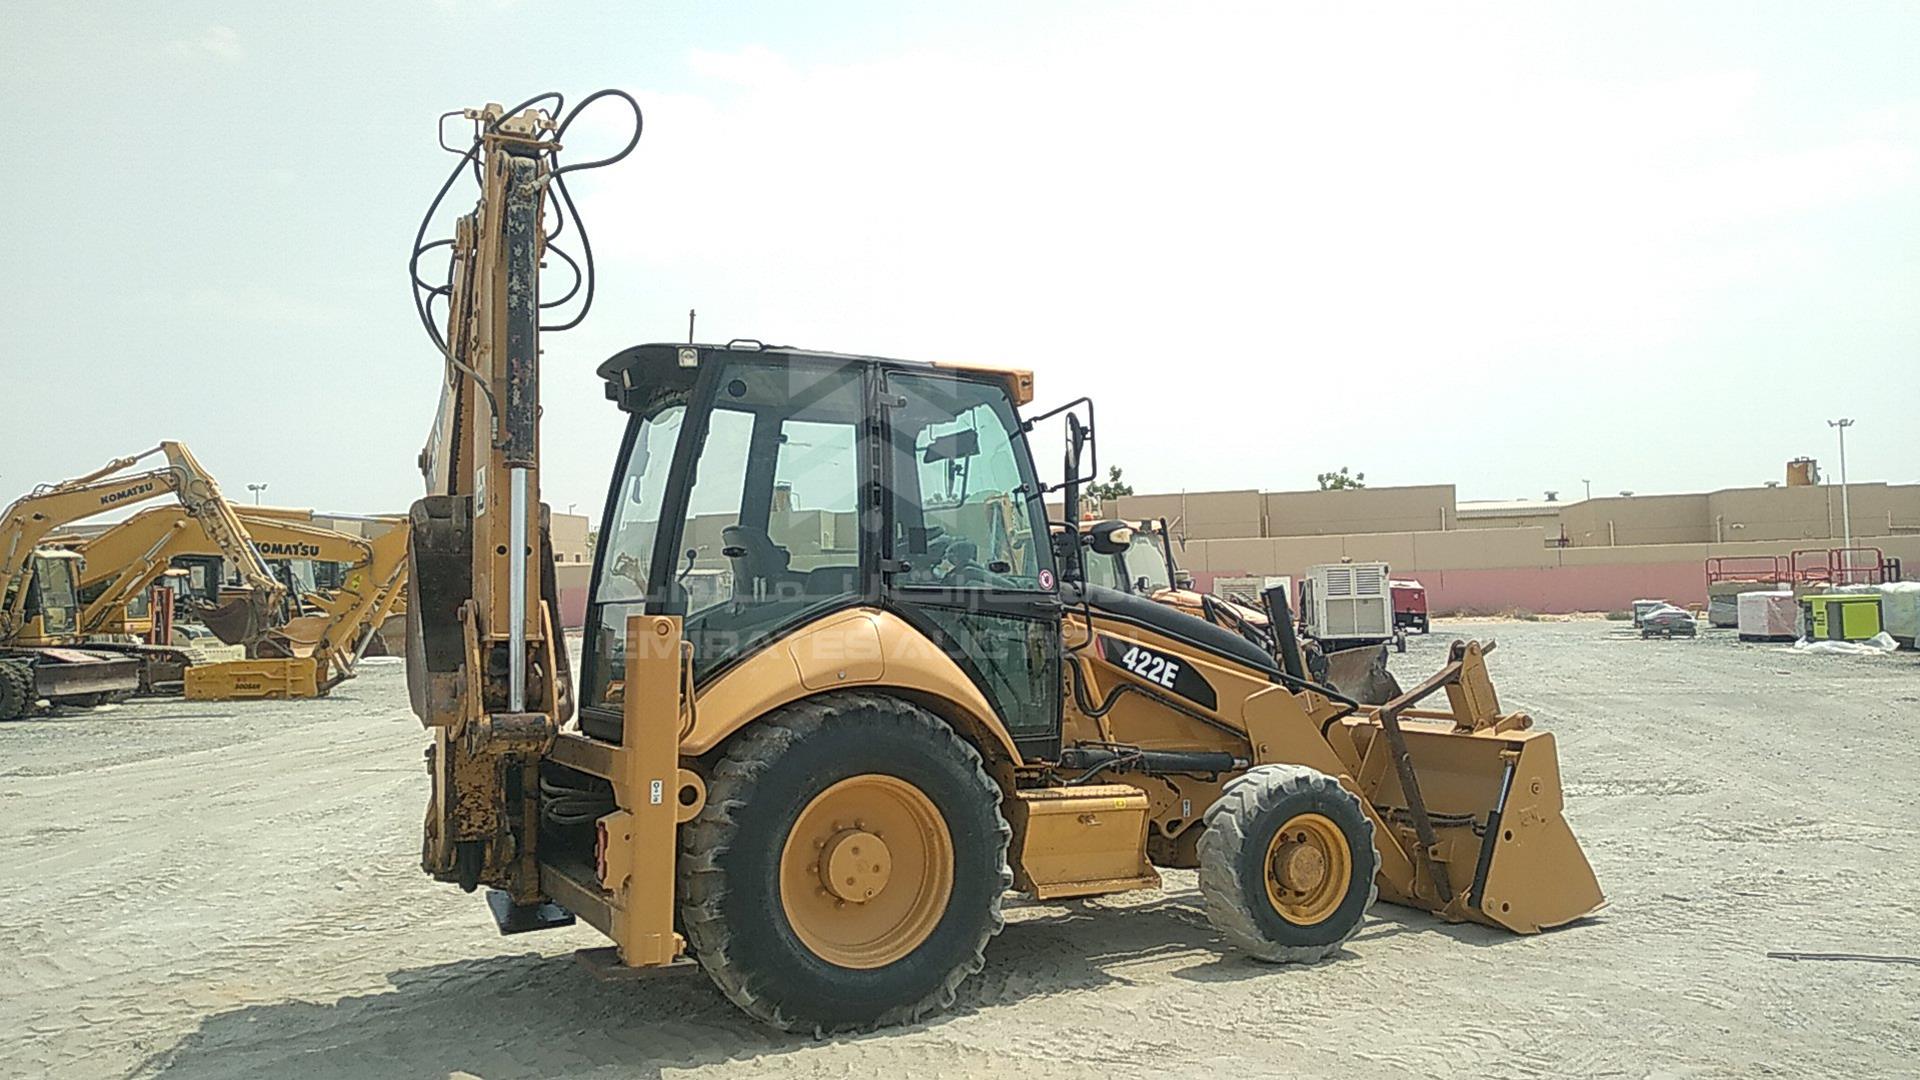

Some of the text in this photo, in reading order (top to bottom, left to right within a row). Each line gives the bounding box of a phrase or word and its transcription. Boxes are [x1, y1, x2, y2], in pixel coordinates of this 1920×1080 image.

[101, 482, 153, 504] KOMATSU
[254, 542, 320, 556] KOMATSU
[1122, 646, 1179, 688] 422E
